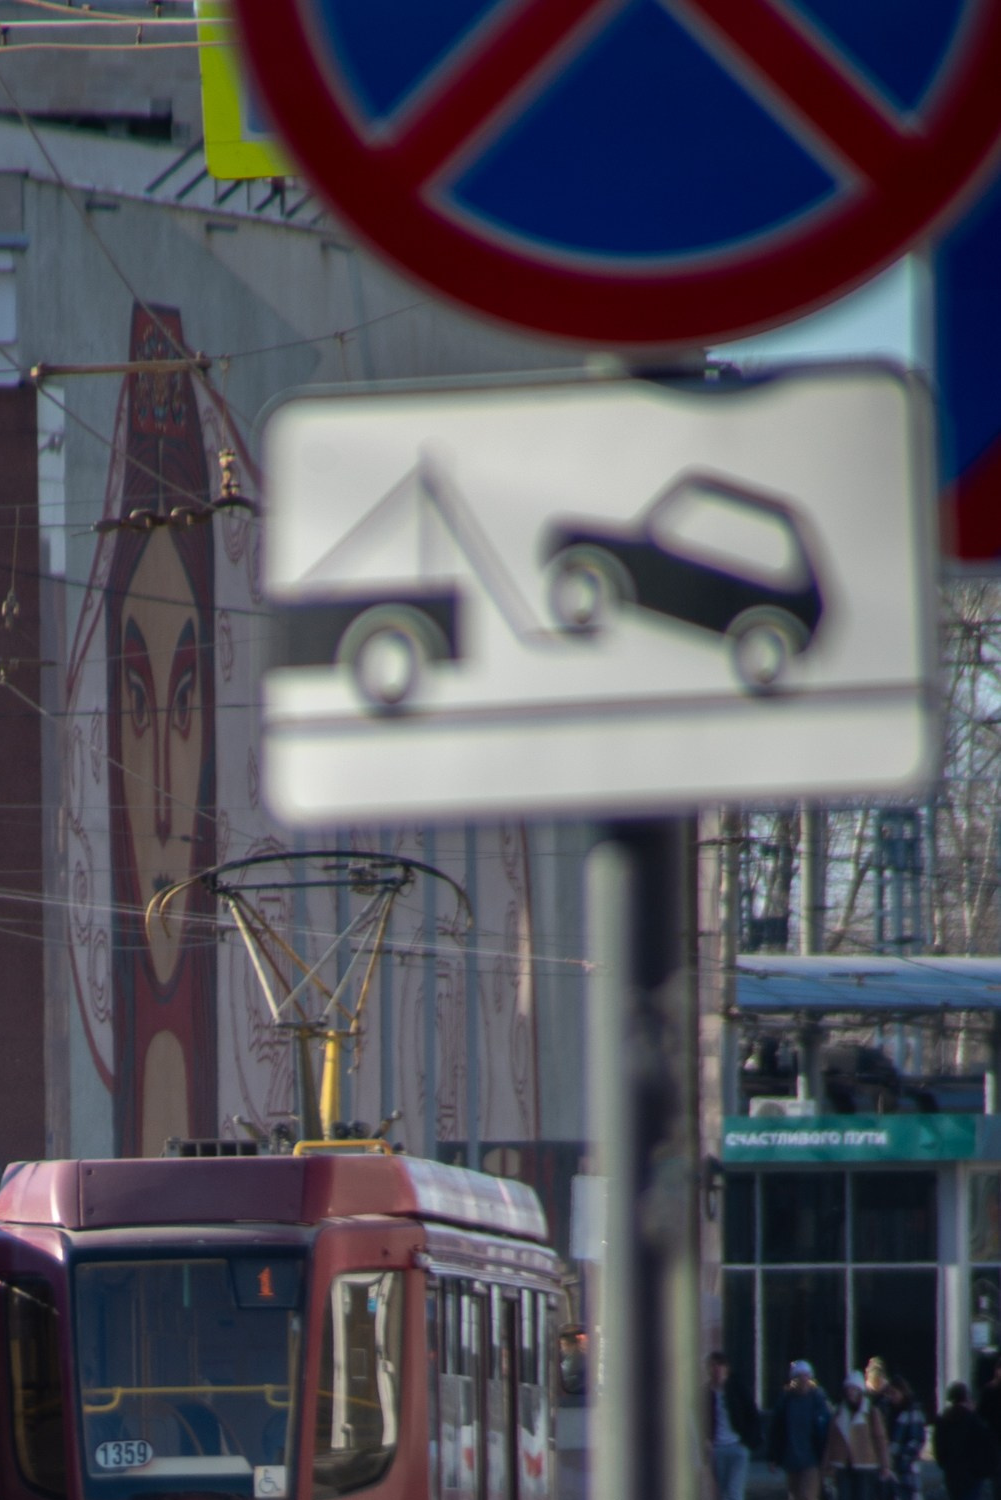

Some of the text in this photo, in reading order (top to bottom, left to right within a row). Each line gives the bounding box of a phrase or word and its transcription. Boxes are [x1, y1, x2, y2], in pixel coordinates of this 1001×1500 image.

[725, 1131, 887, 1146] СЧАСТЛИВОГО ПУТИ
[257, 1266, 274, 1296] 1
[100, 1442, 148, 1465] 1359
